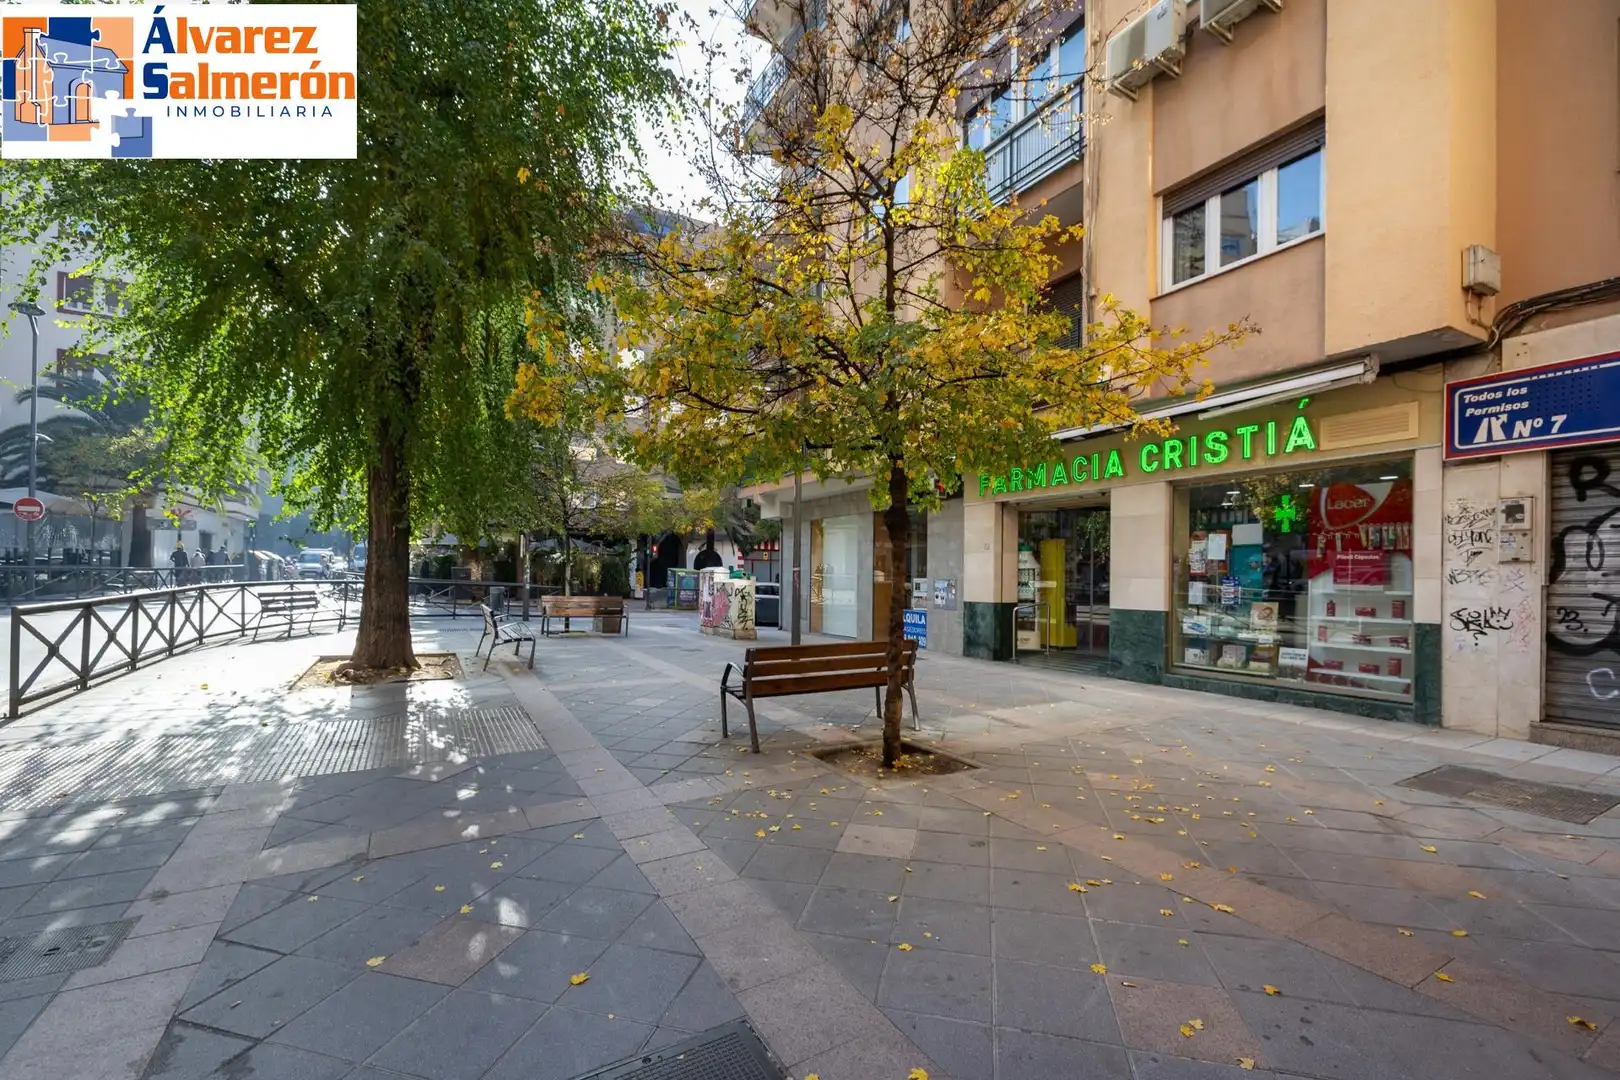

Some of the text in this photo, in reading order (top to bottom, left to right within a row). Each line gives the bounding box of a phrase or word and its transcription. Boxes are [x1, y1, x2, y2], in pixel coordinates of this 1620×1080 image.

[1463, 386, 1528, 404] Todos los
[1465, 400, 1530, 418] Permisos
[1512, 414, 1568, 439] Nº 7
[978, 398, 1317, 497] FARMACIA CRISTIÁ
[1326, 498, 1371, 511] Lacer
